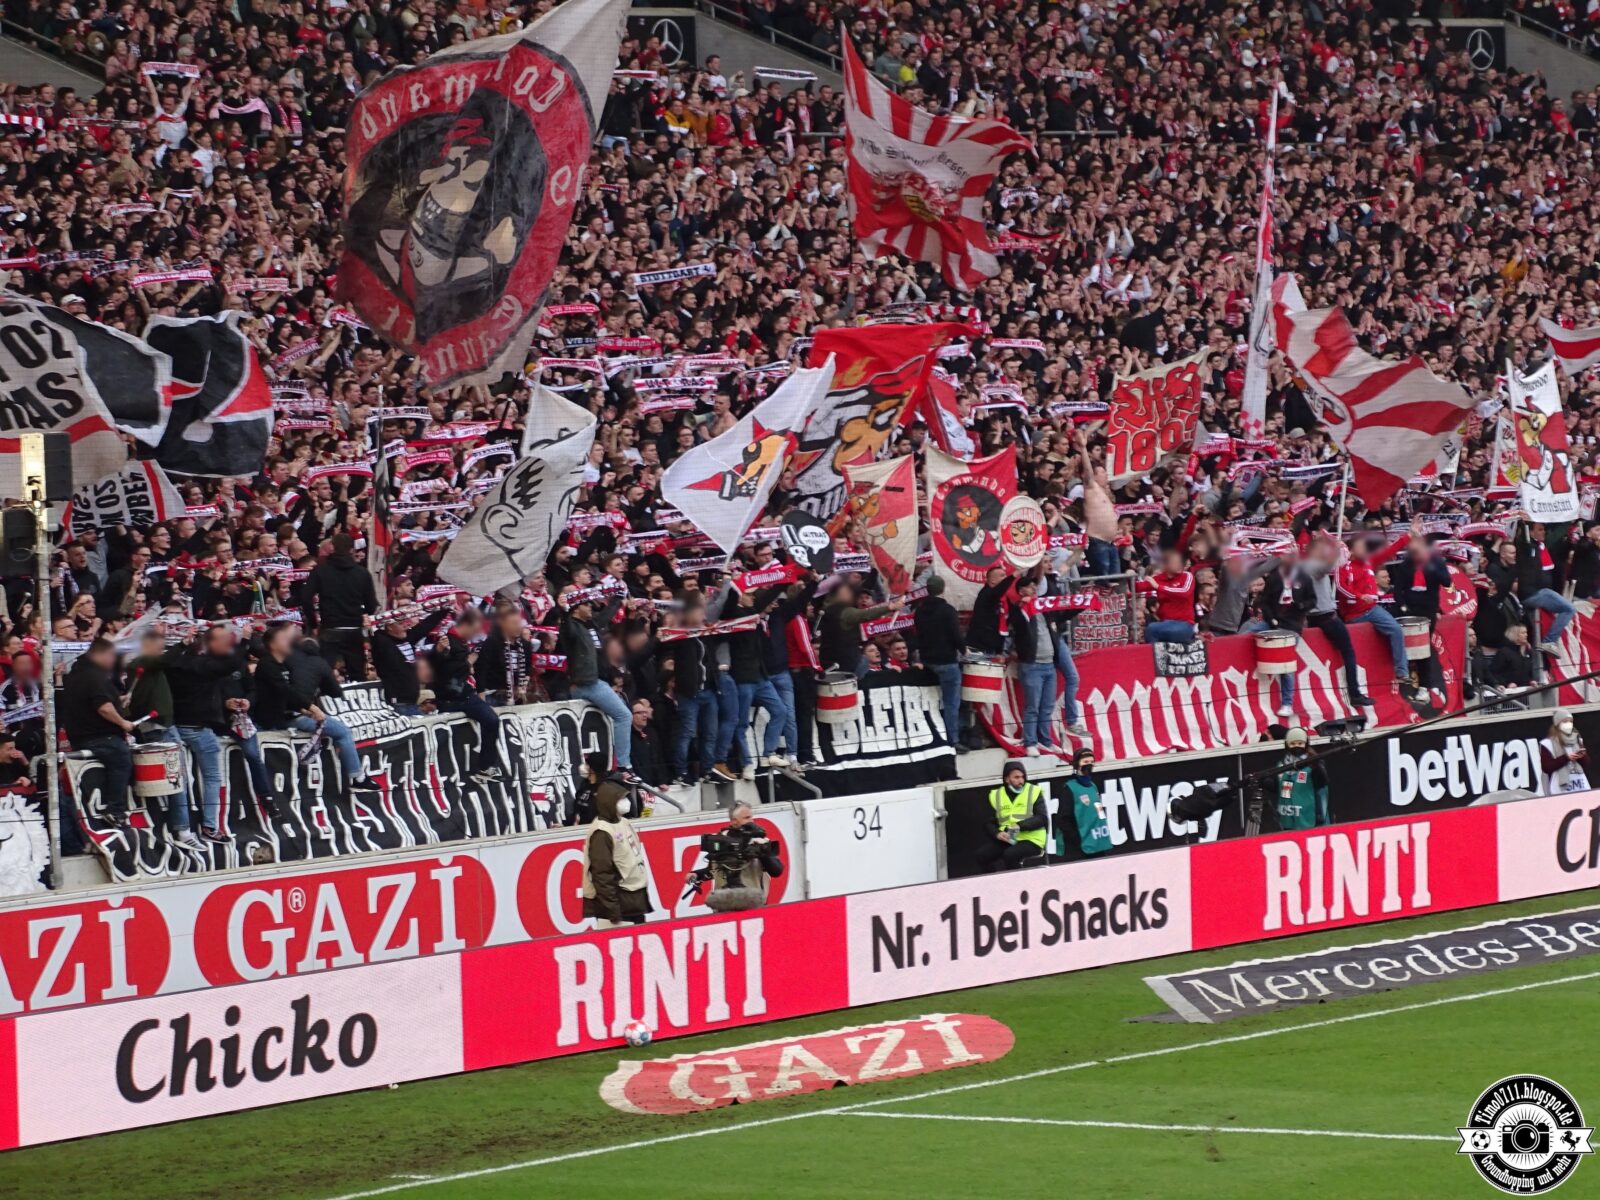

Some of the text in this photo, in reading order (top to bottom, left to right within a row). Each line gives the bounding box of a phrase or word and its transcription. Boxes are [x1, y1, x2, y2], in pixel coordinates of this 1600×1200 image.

[1034, 596, 1057, 610] CC
[1074, 594, 1094, 607] 97
[332, 706, 402, 728] EDEUTE
[351, 715, 412, 741] DERSTAND
[852, 804, 884, 841] 34
[1091, 825, 1110, 840] HO
[1262, 821, 1432, 931] RINTI
[871, 873, 1169, 974] Nr. 1 bei Snacks
[552, 916, 768, 1047] RINTI
[1183, 921, 1600, 1015] Mercedes-Be
[115, 994, 378, 1104] Chicko
